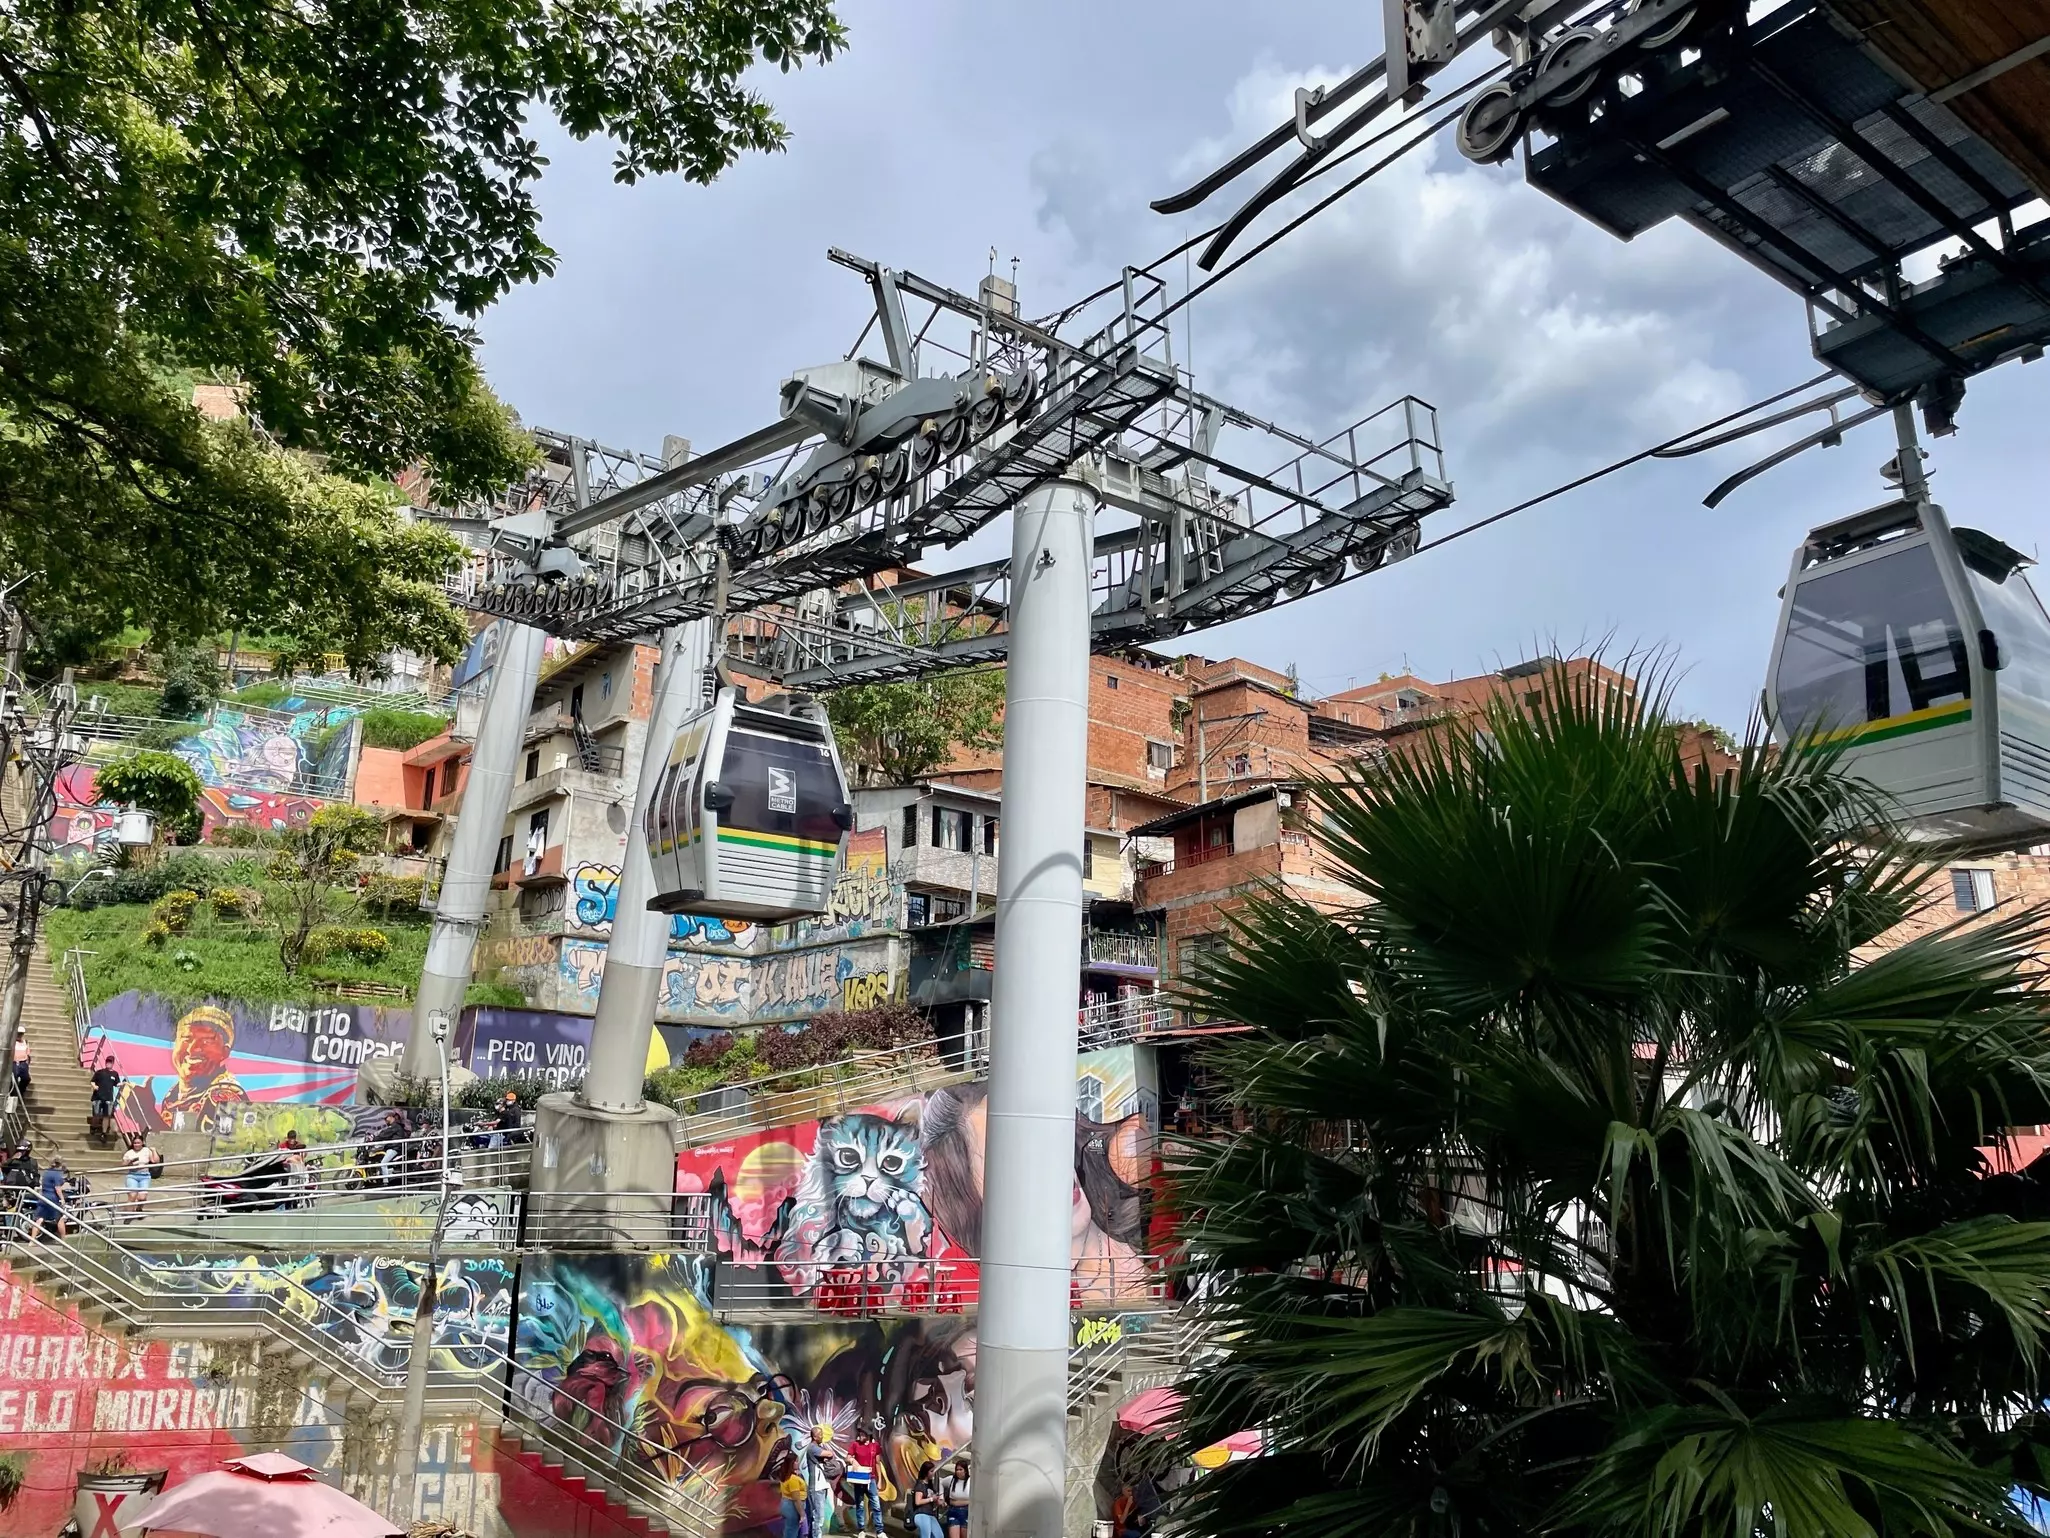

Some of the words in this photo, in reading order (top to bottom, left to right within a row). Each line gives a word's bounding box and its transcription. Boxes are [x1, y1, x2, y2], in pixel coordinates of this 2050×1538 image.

[819, 748, 830, 758] 16
[771, 797, 794, 805] METRO
[771, 802, 793, 810] CABLE
[269, 1004, 351, 1037] Barrio
[545, 1042, 585, 1067] VINO
